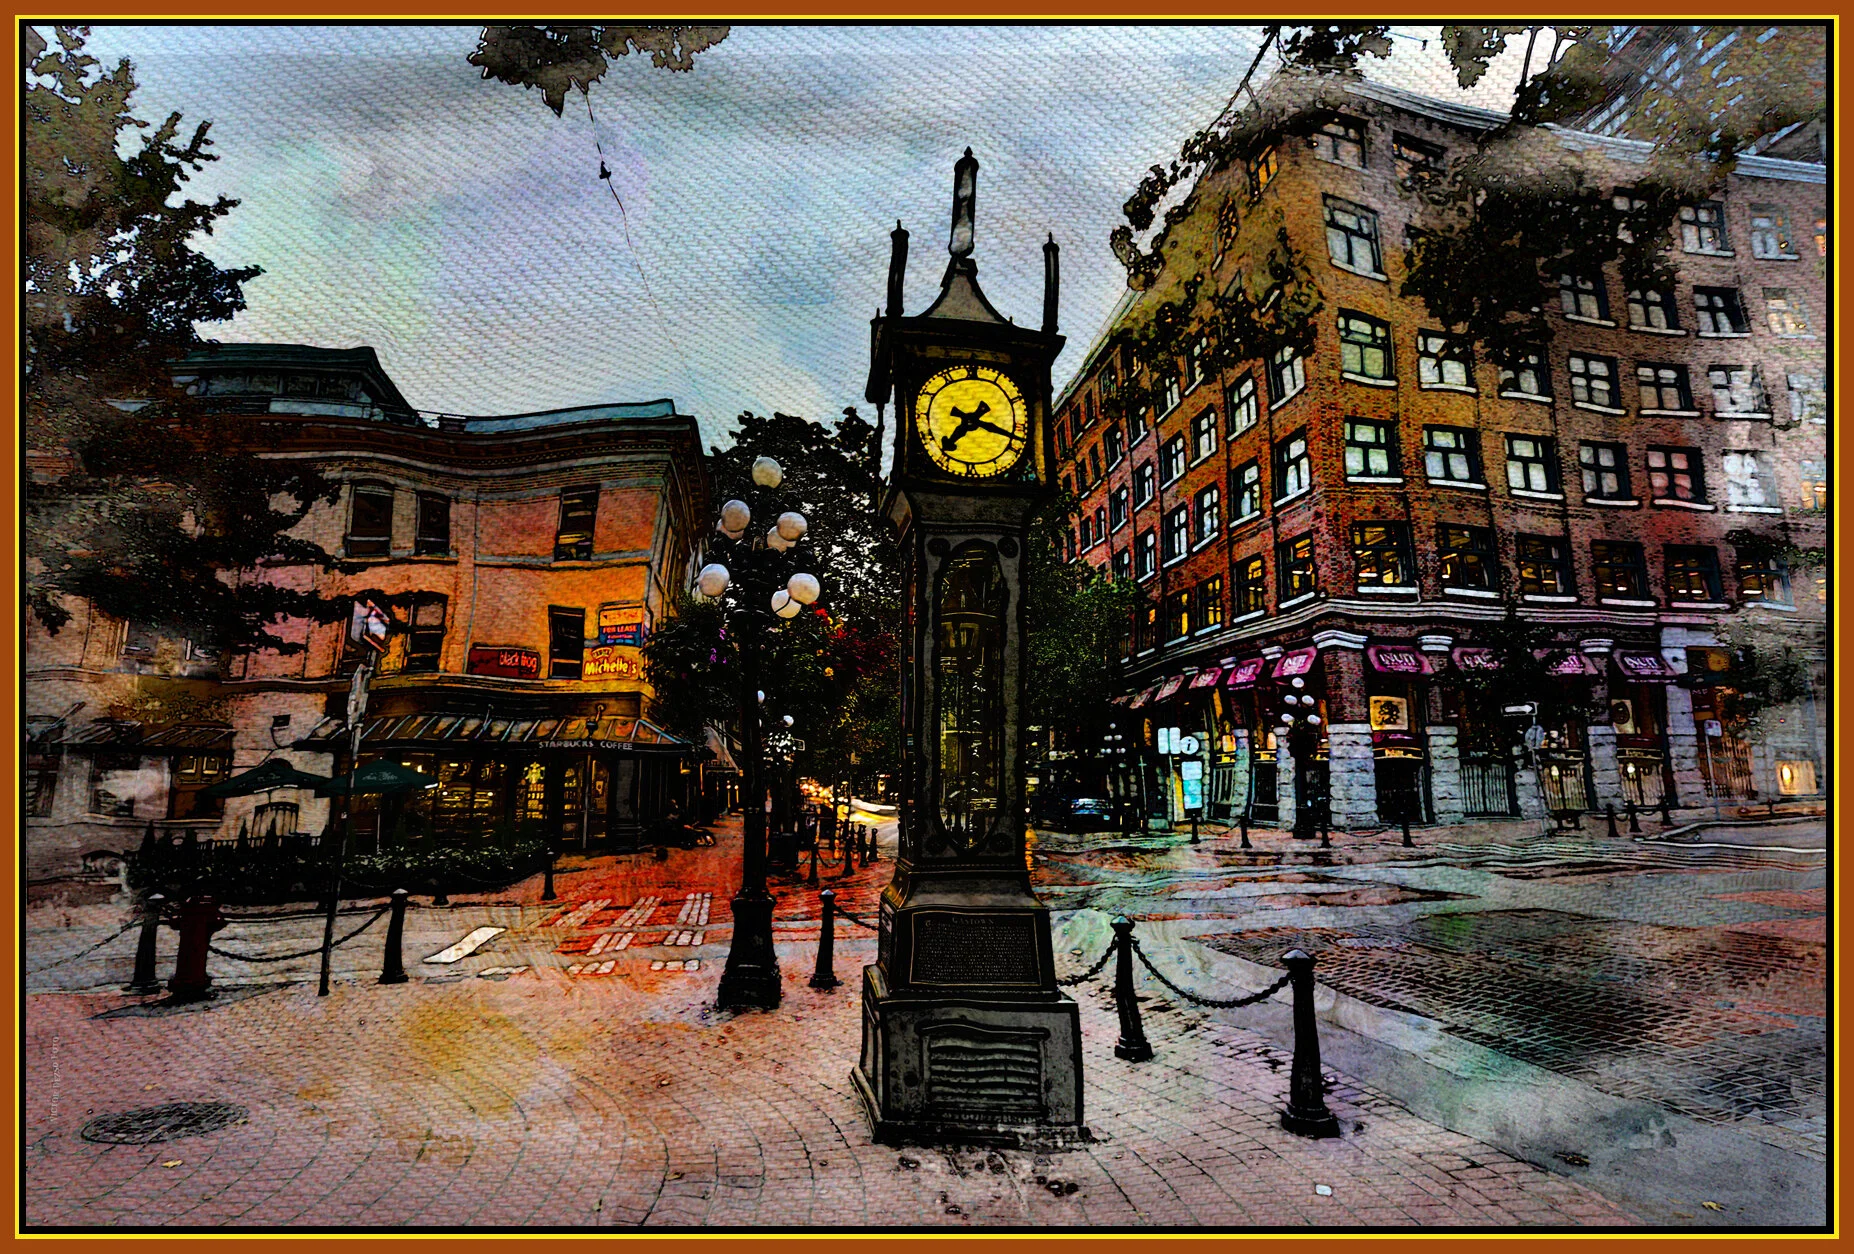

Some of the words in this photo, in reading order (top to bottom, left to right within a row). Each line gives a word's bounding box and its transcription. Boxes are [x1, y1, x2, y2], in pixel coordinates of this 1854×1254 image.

[602, 626, 616, 634] FOR
[617, 625, 637, 633] LEASE
[499, 651, 519, 666] black
[521, 651, 537, 672] frog
[584, 657, 637, 675] Michelle's
[539, 740, 594, 749] STARBUCKS
[600, 741, 633, 750] COFFEE
